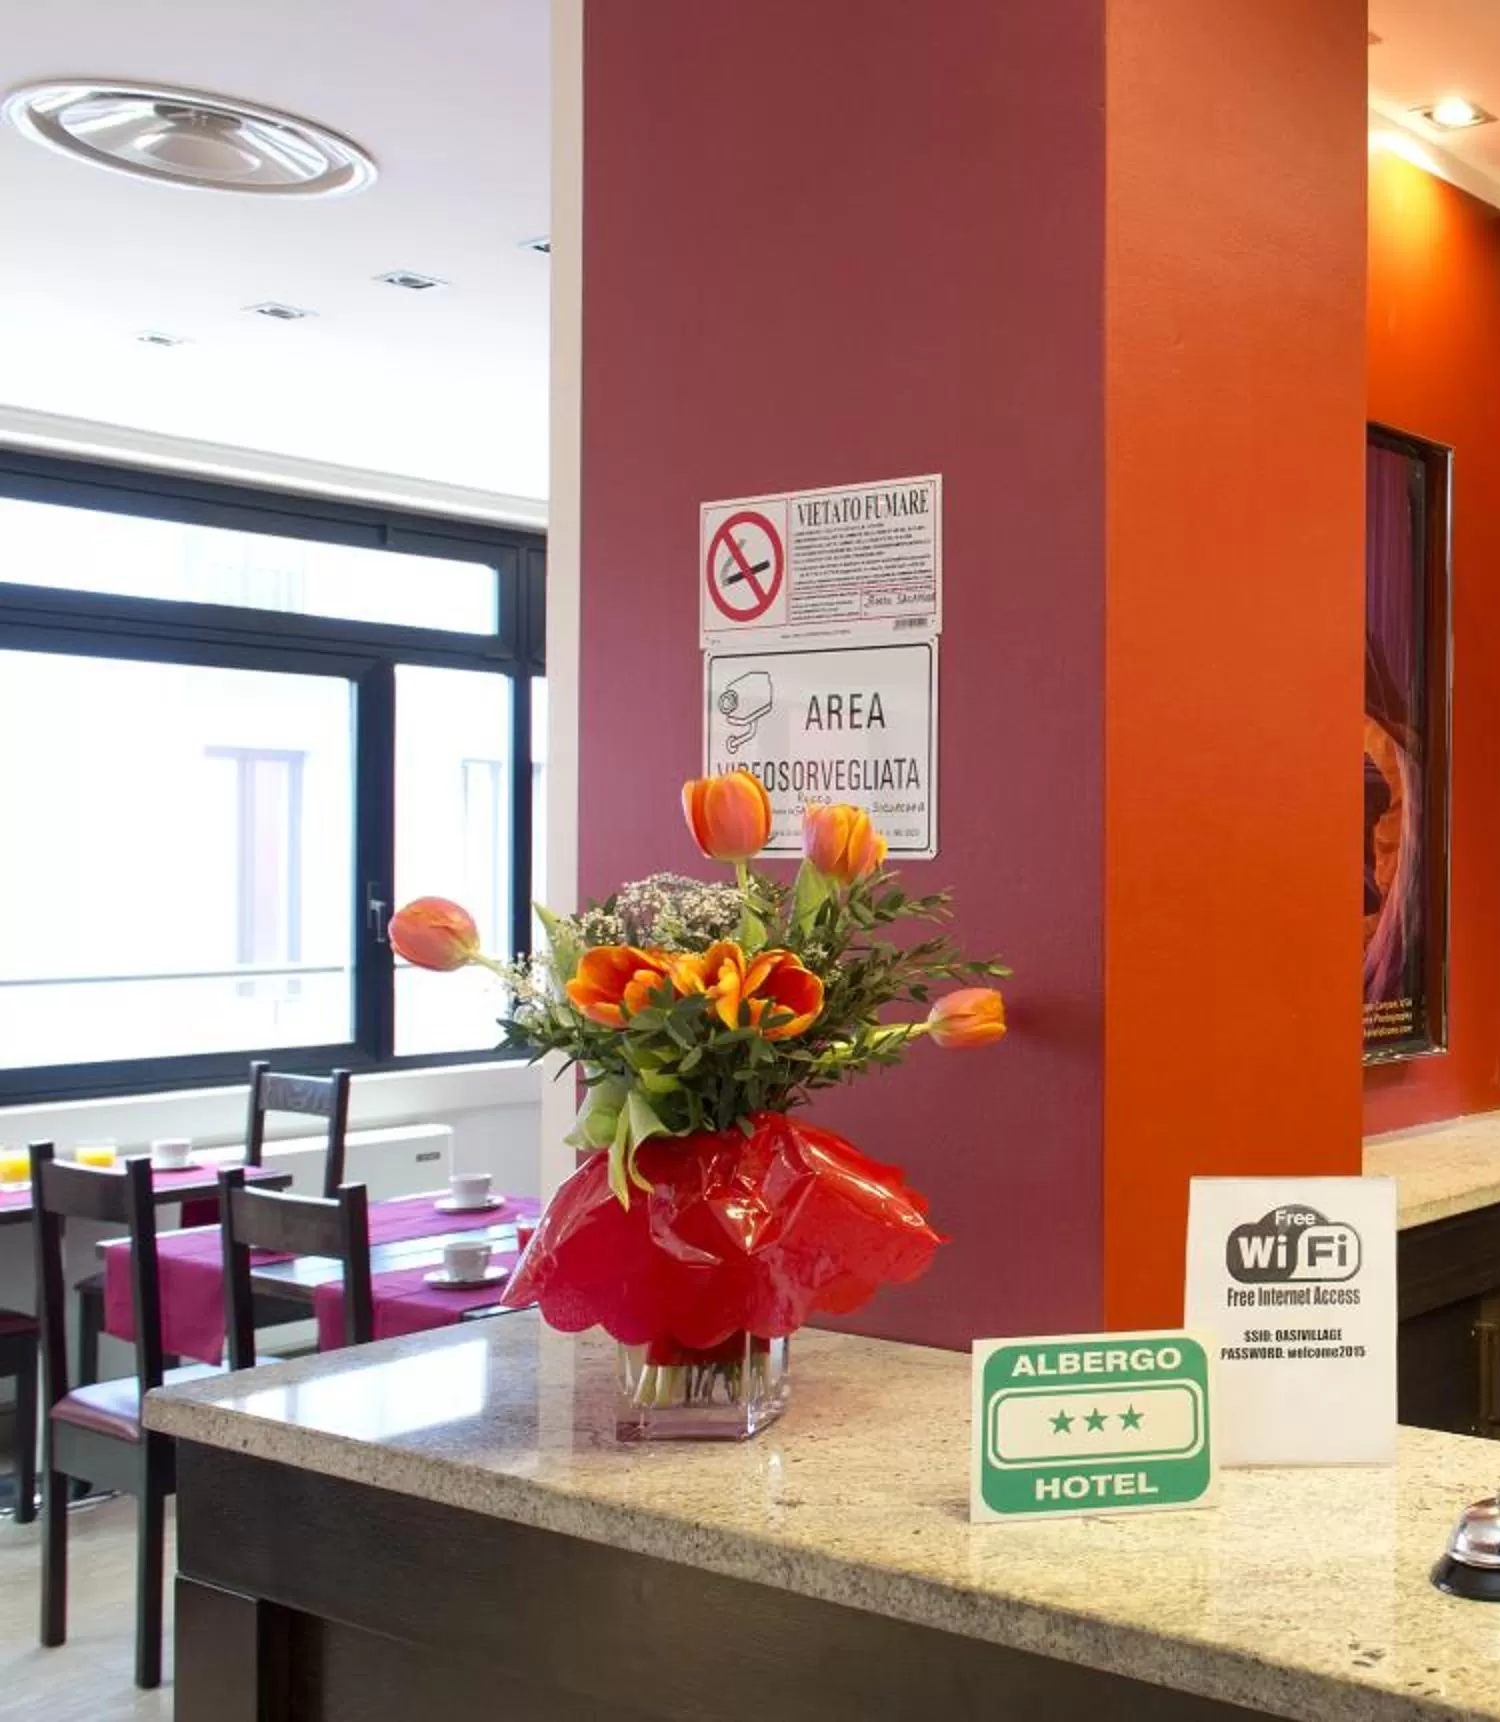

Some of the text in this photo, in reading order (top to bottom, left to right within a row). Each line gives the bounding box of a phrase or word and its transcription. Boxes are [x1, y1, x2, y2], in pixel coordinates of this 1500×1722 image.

[797, 489, 929, 526] VIETATO FUMARE
[805, 692, 886, 731] AREA
[1275, 1209, 1317, 1226] Free
[1227, 1285, 1361, 1308] Free Internet Access
[1243, 1328, 1343, 1343] SSID: OASIVILLAGE
[1011, 1347, 1182, 1378] ALBERGO
[1287, 1345, 1367, 1359] welcome2015
[1035, 1471, 1160, 1501] HOTEL
